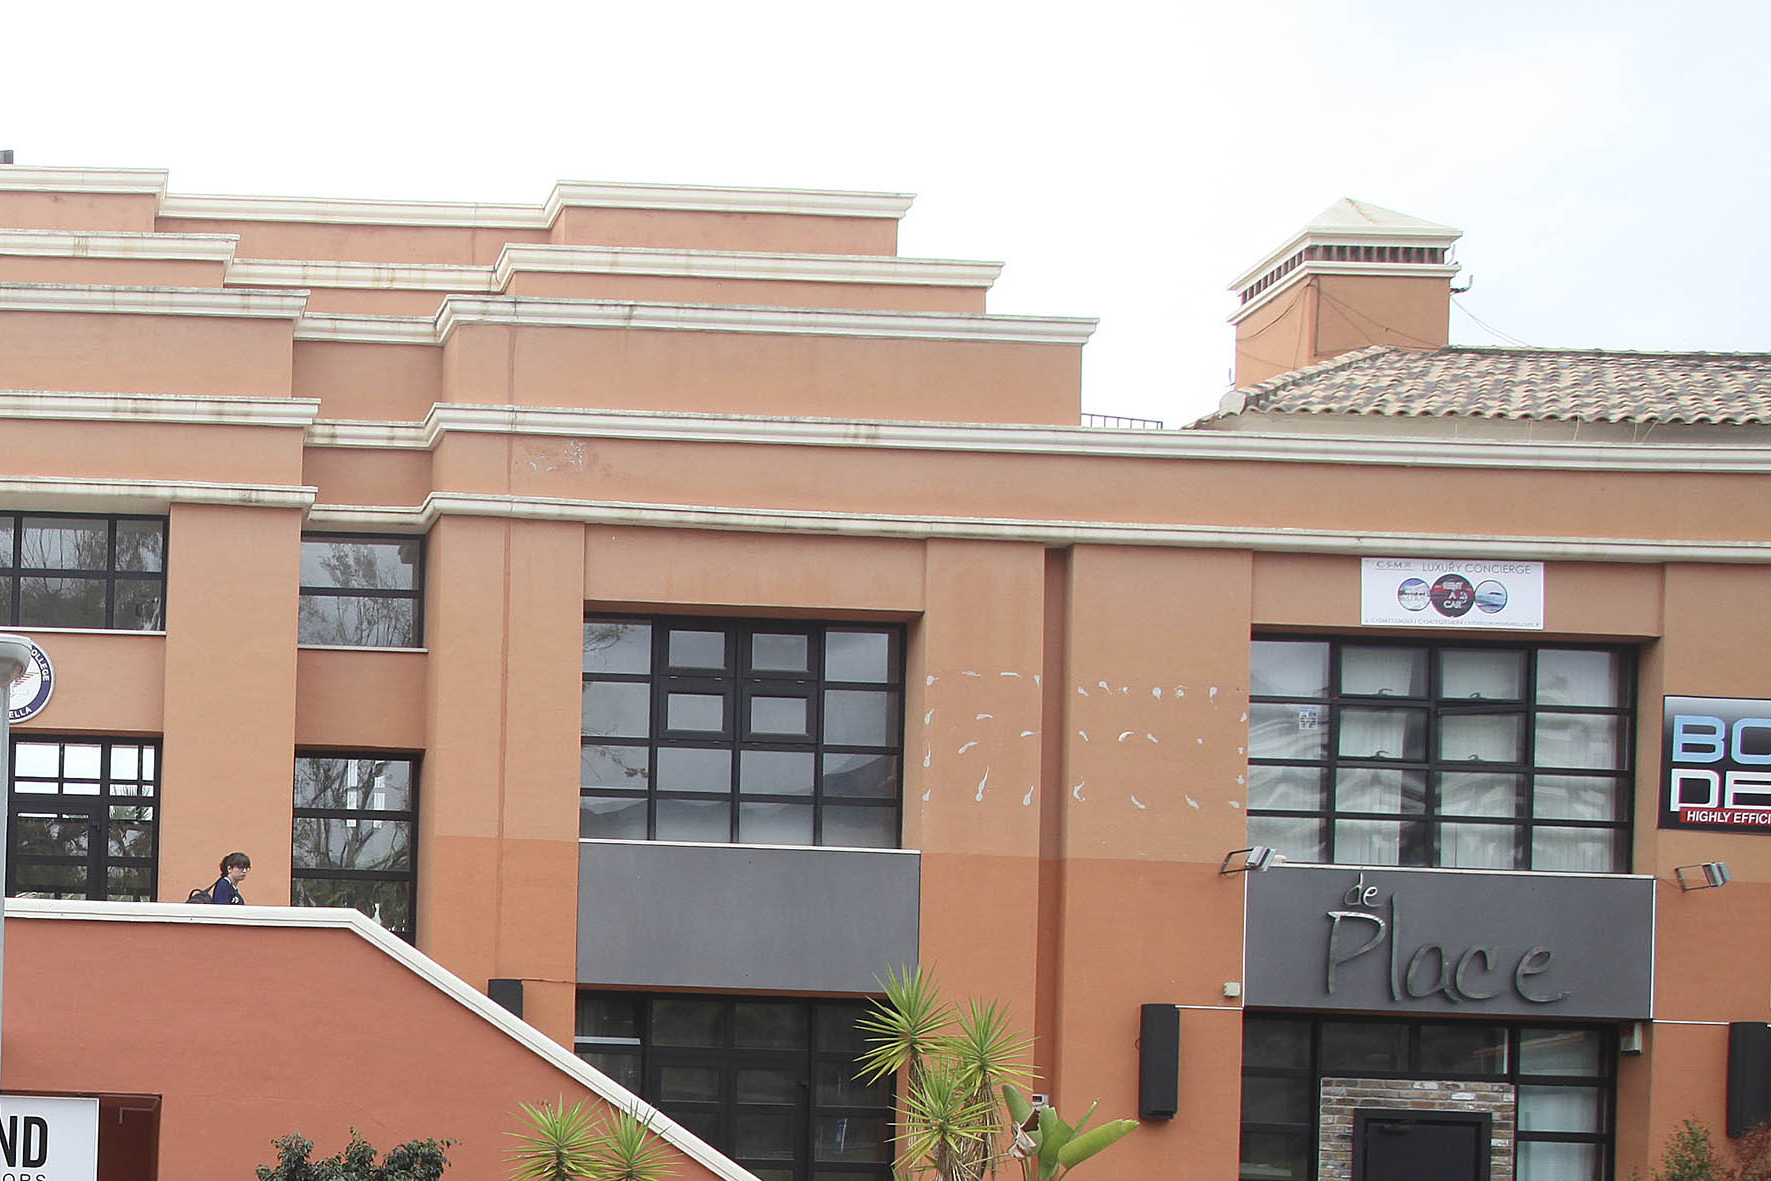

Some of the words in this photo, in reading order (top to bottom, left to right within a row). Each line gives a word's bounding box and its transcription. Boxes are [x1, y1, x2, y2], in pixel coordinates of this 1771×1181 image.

[1422, 562, 1461, 573] LUXURY
[1464, 563, 1531, 575] CONCIERGE
[31, 648, 50, 682] OLLEGE
[1686, 810, 1731, 823] HIGHLY
[1343, 872, 1383, 908] de
[1326, 892, 1573, 1004] Place
